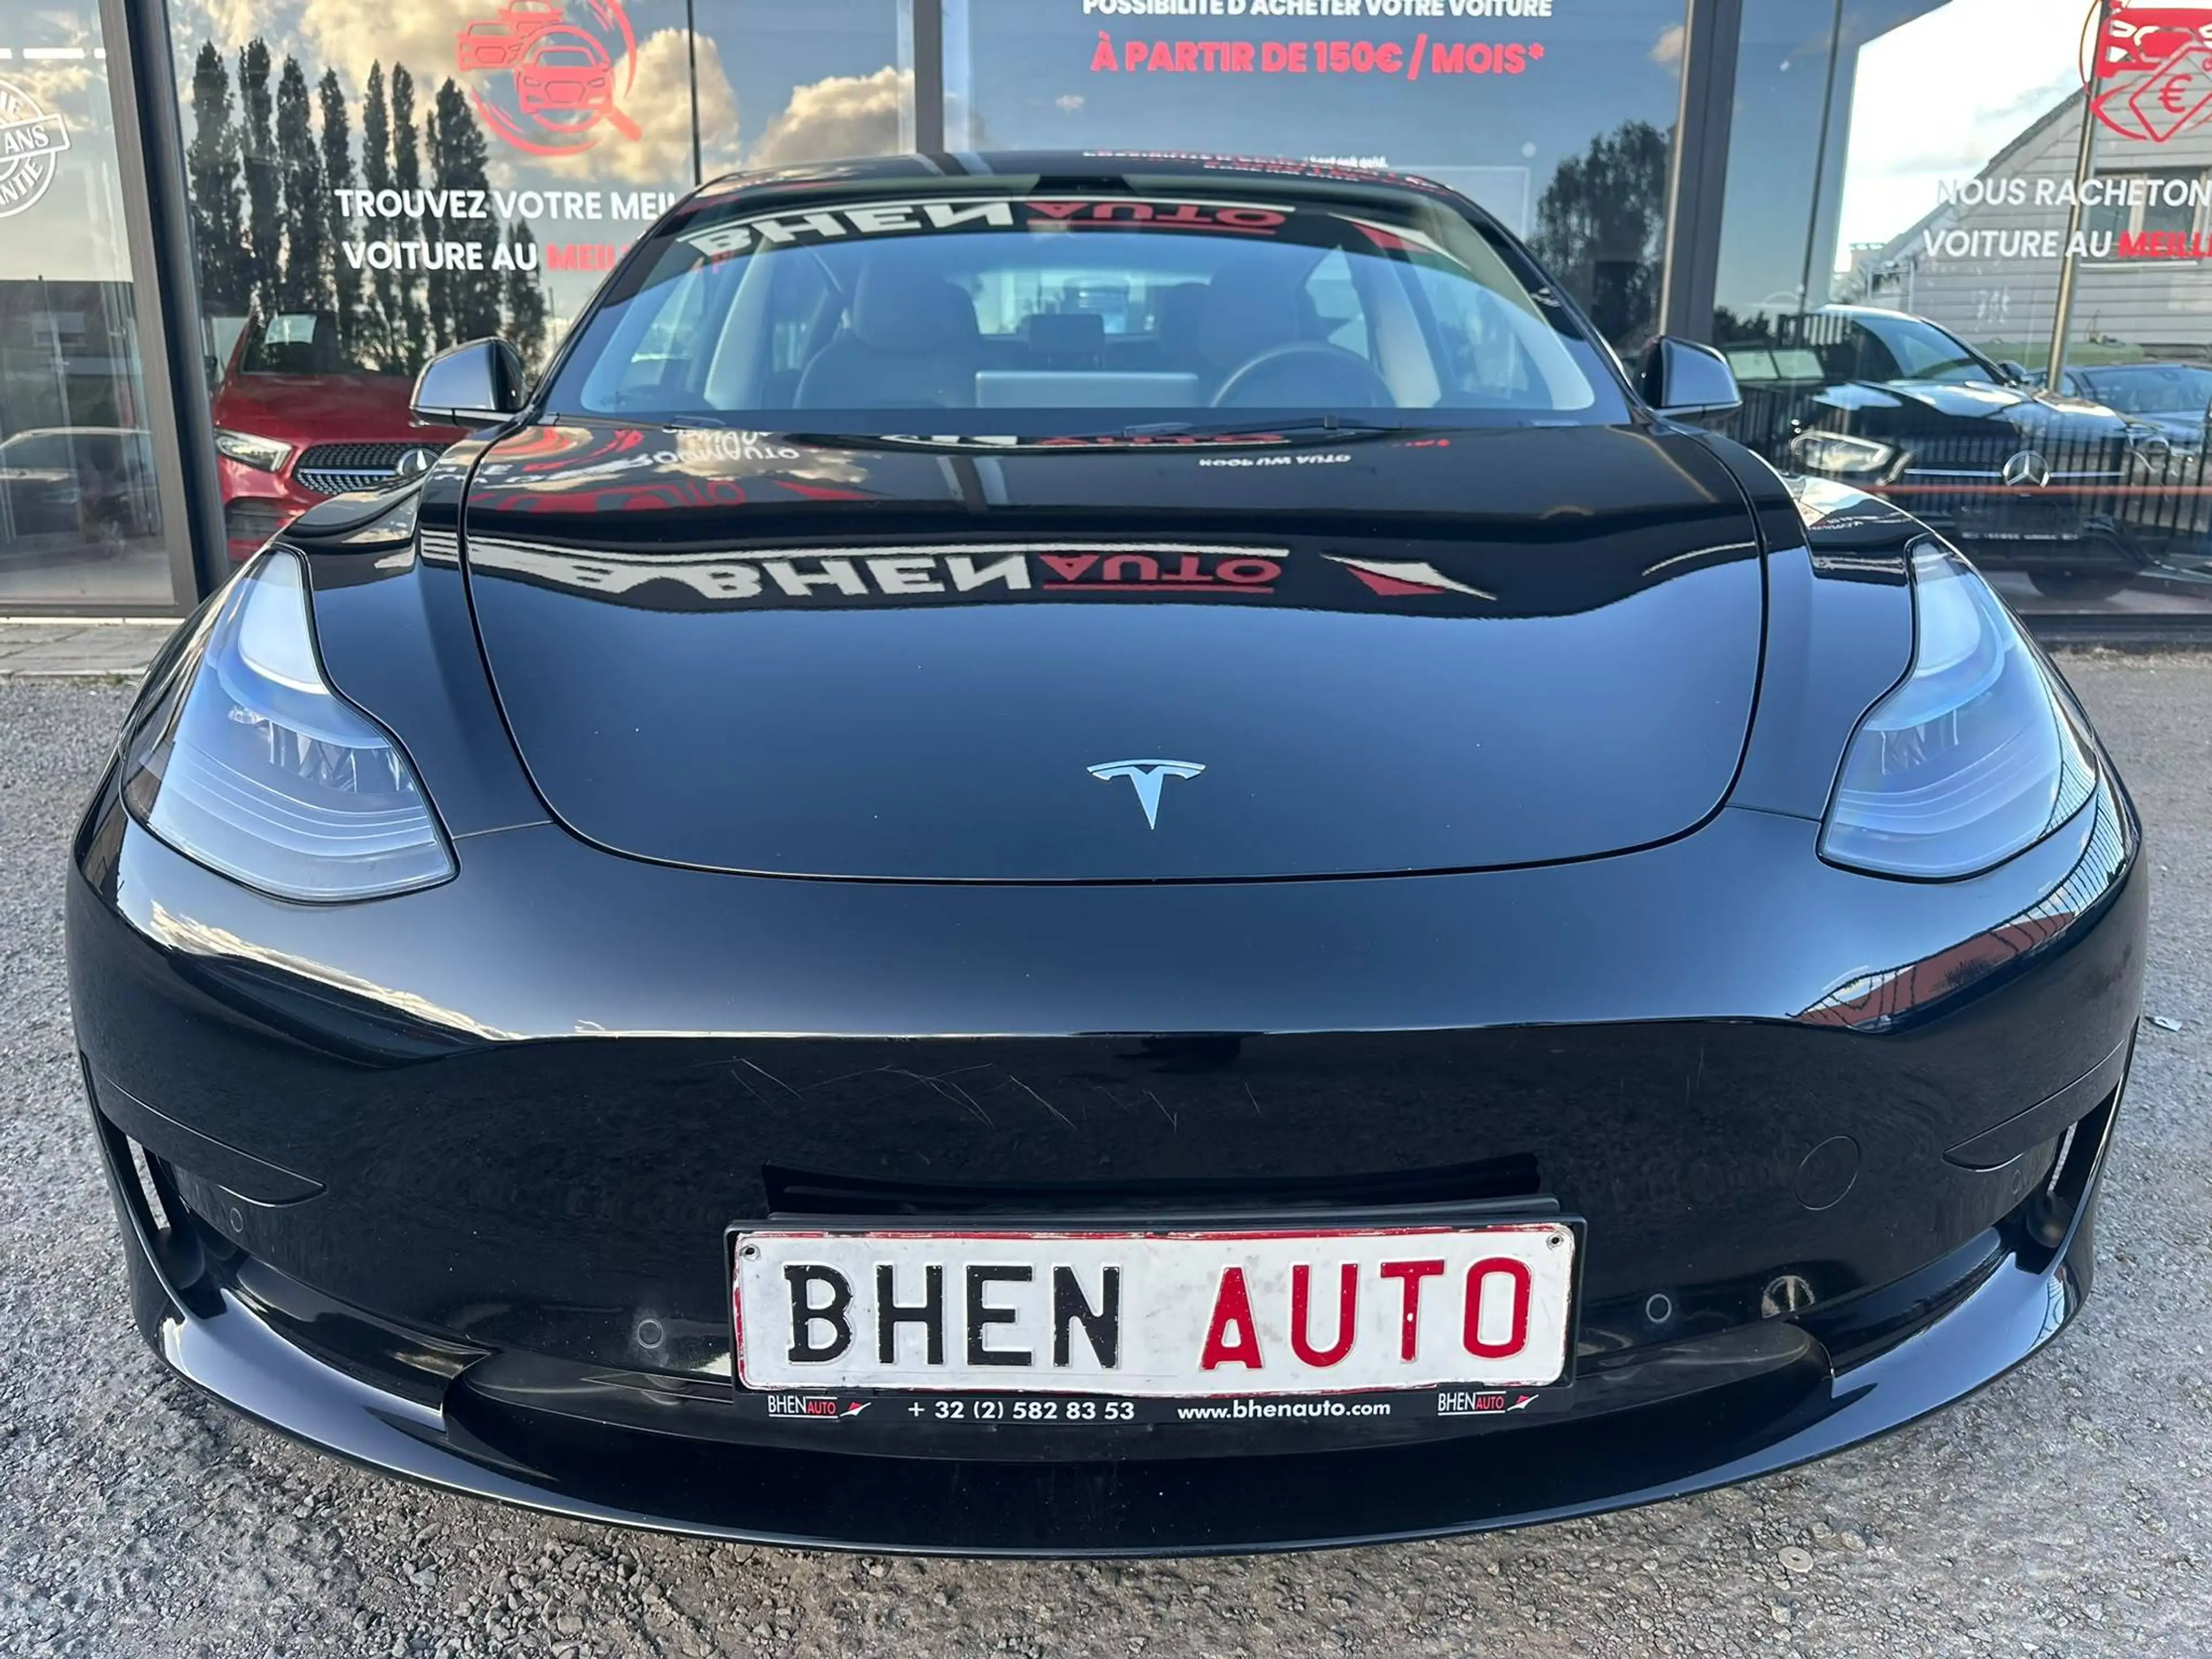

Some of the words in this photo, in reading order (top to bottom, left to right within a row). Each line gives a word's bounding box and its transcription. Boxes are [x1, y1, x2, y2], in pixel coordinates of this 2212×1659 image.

[1366, 0, 1445, 16] VOTRE
[1450, 0, 1552, 17] VOITURE
[1090, 30, 1119, 71] À
[1125, 41, 1255, 72] PARTIR
[1262, 42, 1308, 73] DE
[1313, 41, 1403, 73] 150€
[5, 124, 50, 154] ANS
[334, 190, 488, 219] TROUVEZ
[493, 192, 602, 220] VOTRE
[1937, 178, 2027, 206] NOUS
[341, 242, 483, 270] VOITURE
[491, 243, 537, 271] AU
[1923, 229, 2059, 258] VOITURE
[2065, 229, 2112, 258] AU
[783, 1264, 1119, 1369] BHEN
[1199, 1256, 1532, 1371] AUTO
[908, 1402, 925, 1417] +
[934, 1402, 964, 1418] 32
[974, 1400, 1003, 1419] (2)
[1013, 1402, 1058, 1418] 582
[1066, 1402, 1096, 1418] 83
[1104, 1402, 1135, 1419] 53
[1177, 1400, 1391, 1419] www.bhenauto.com
